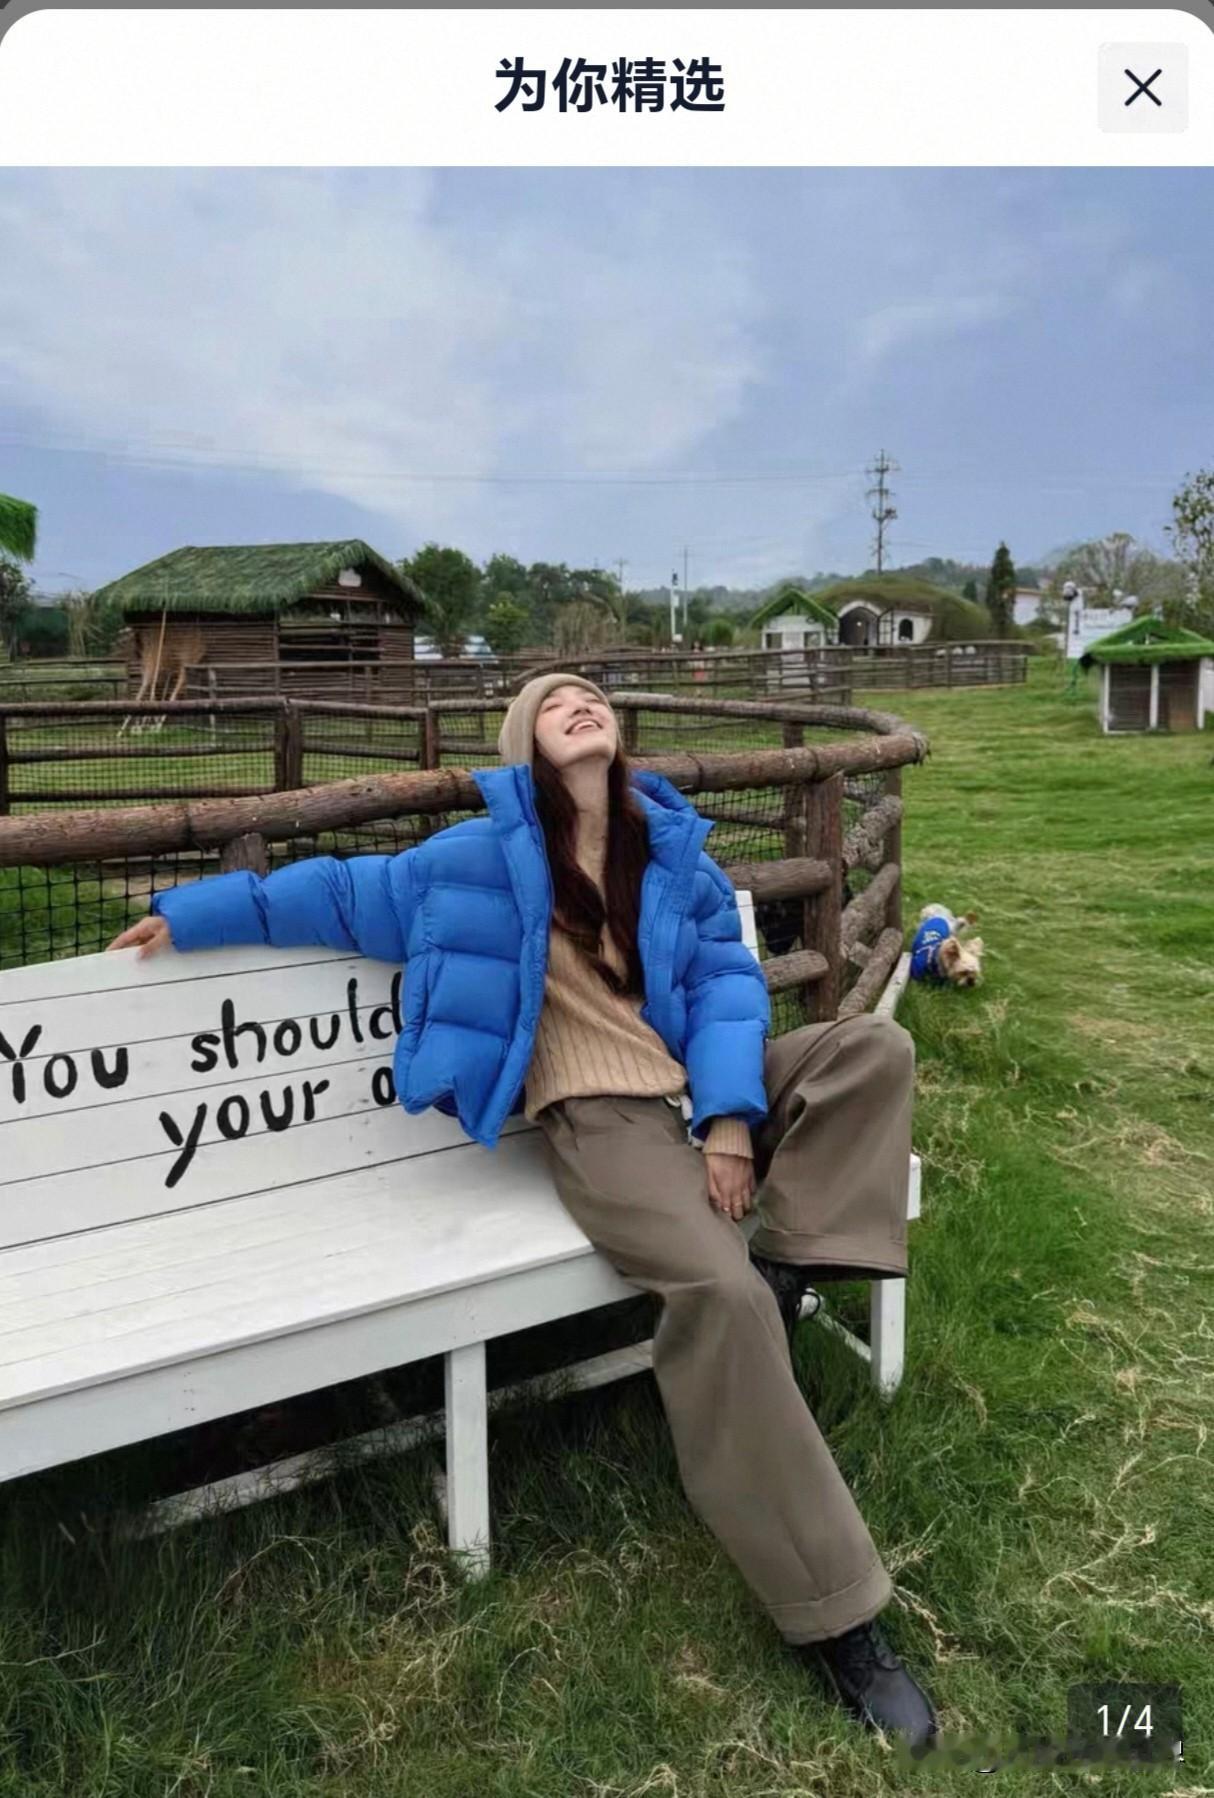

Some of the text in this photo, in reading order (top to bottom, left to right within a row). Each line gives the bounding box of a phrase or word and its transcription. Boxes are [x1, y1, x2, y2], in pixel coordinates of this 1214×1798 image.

[0, 971, 403, 1104] You should
[158, 1078, 330, 1188] your
